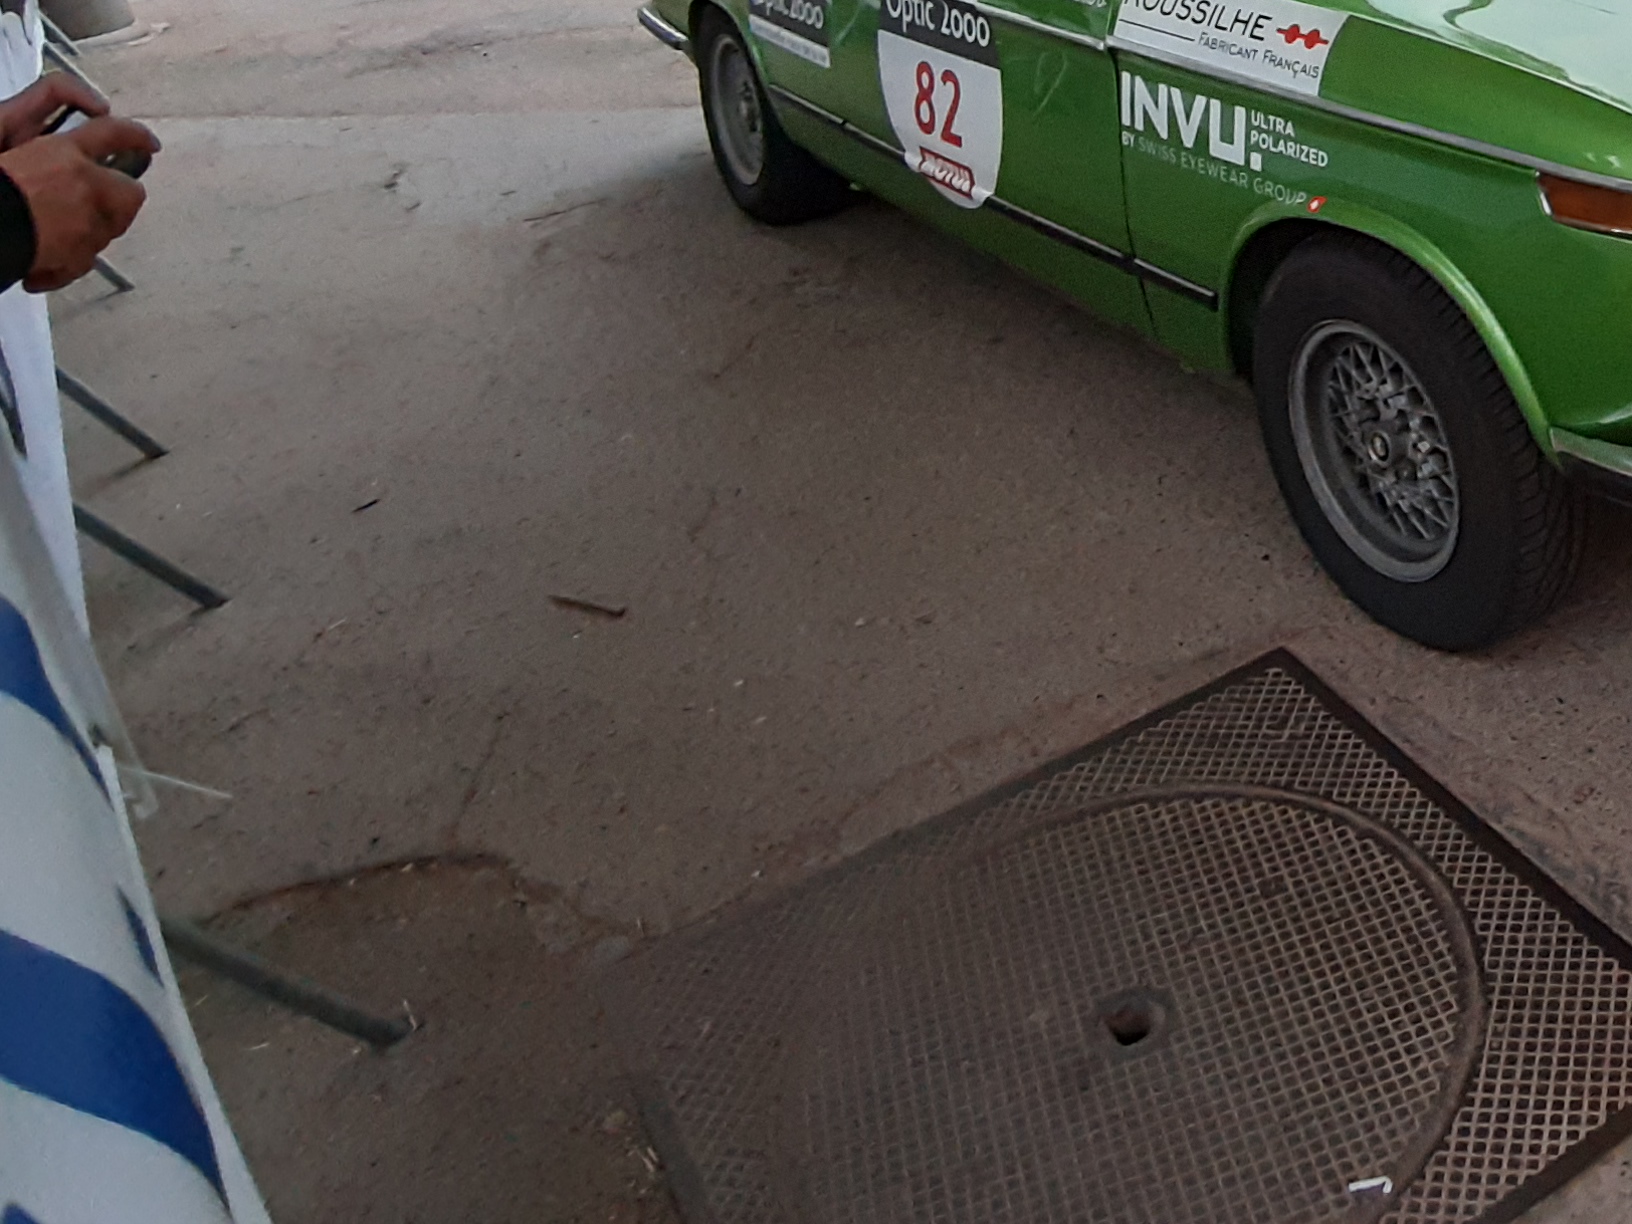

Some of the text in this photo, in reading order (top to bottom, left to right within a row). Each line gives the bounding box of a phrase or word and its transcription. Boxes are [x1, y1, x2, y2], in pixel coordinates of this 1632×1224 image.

[940, 2, 991, 48] 2000
[1199, 31, 1320, 79] FABRICANT FRANÇAIS
[914, 60, 962, 148] 82
[1250, 109, 1295, 138] ULTRA
[1121, 130, 1307, 207] BY SWISS EYEWEAR GROUP
[1250, 130, 1329, 169] POLARIZED
